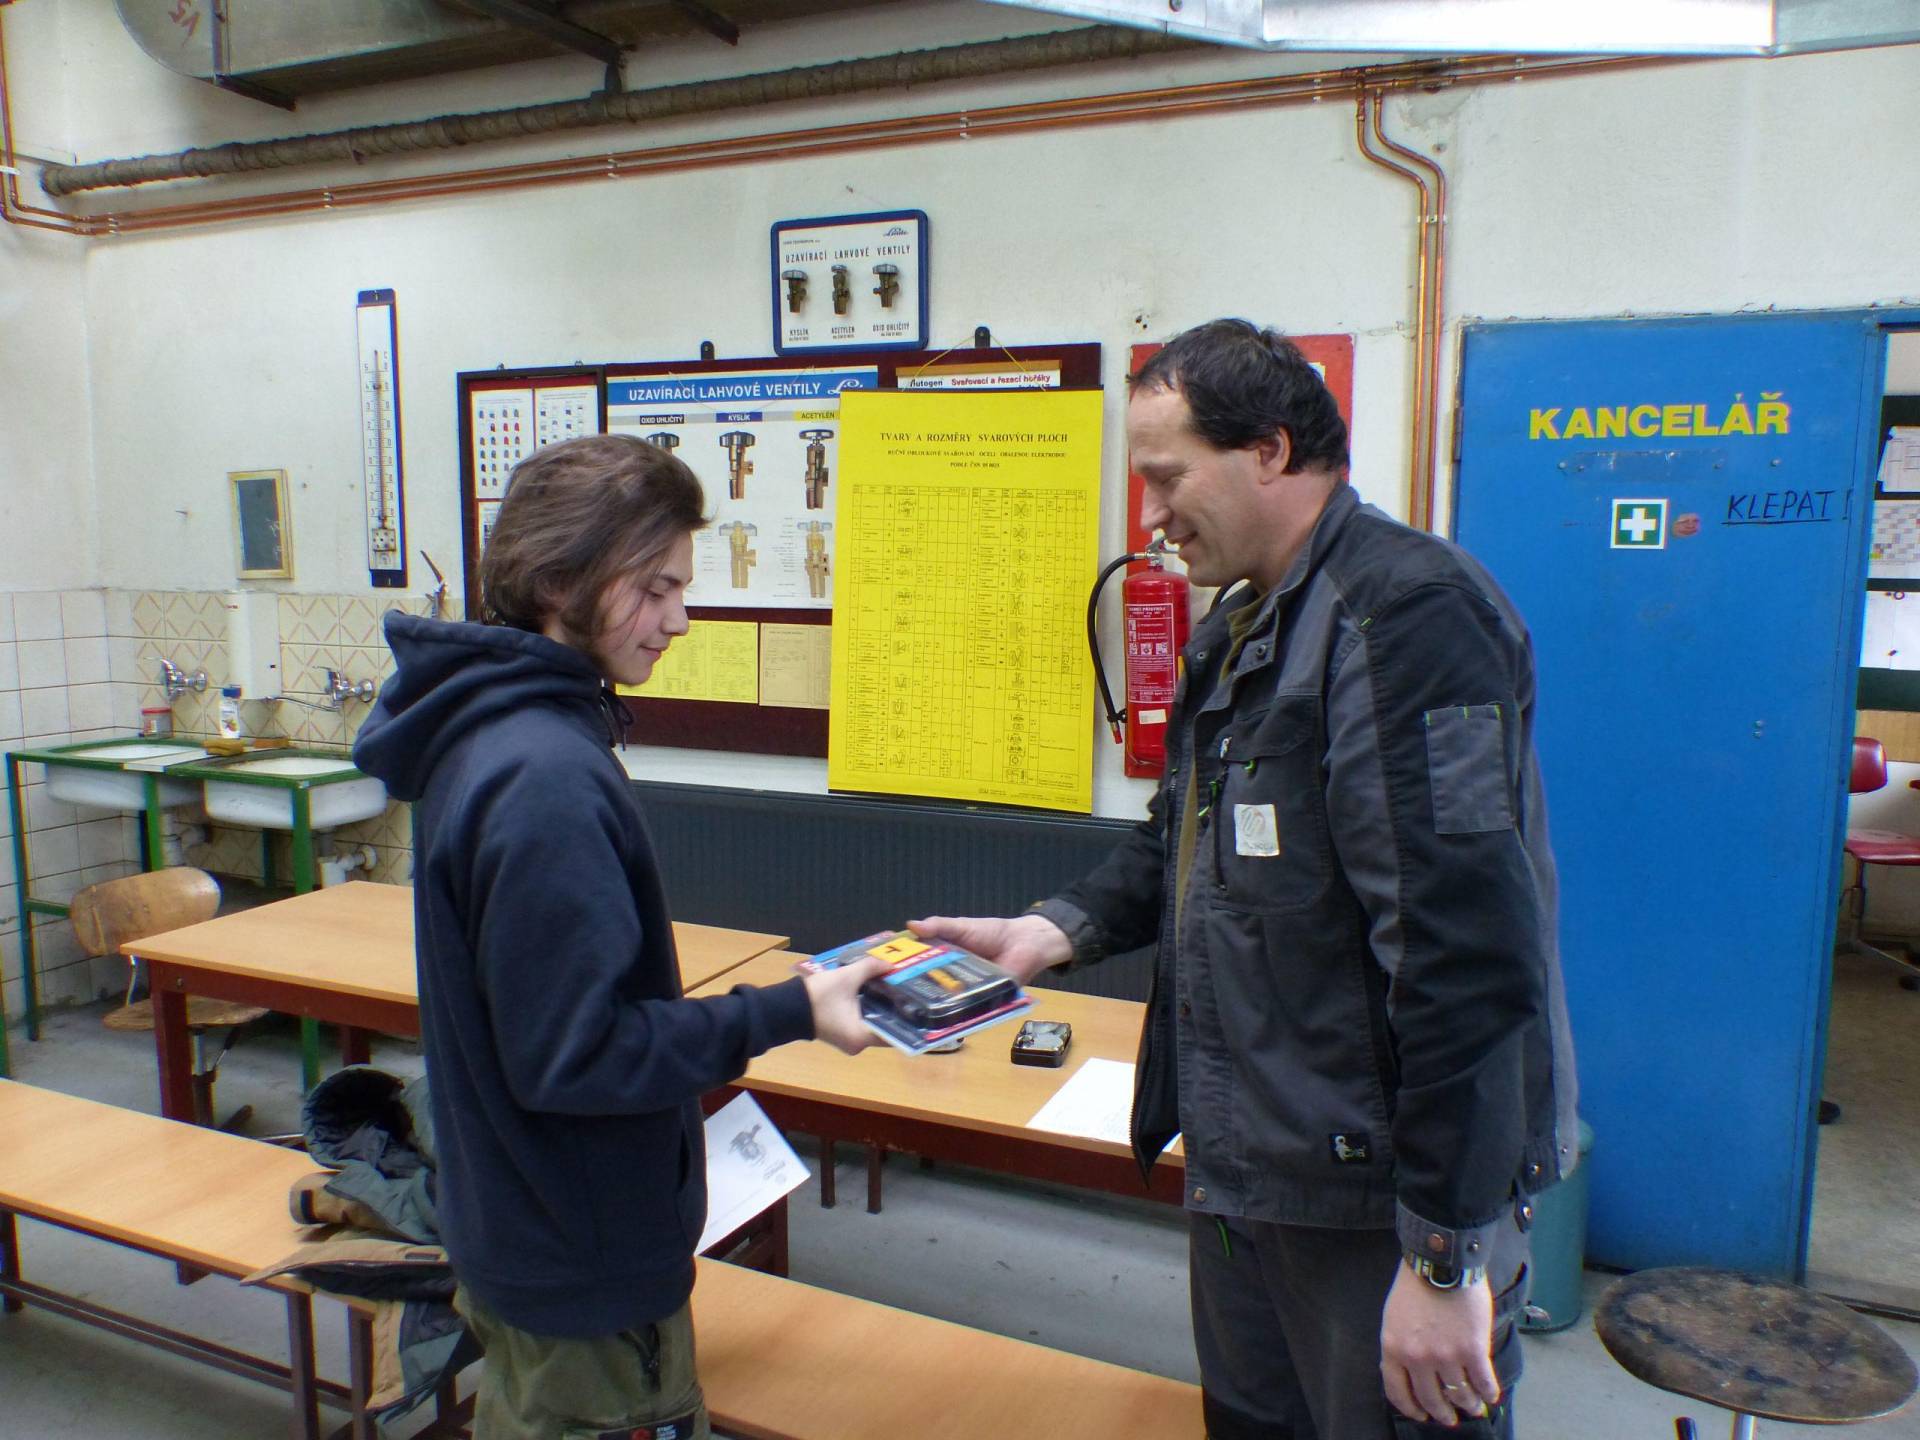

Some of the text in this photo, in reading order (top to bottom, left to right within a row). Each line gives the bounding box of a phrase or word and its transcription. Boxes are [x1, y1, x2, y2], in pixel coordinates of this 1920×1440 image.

[785, 244, 911, 263] UZAVÍRACÍ LAHVOVÉ VENTILY
[909, 379, 943, 388] Autogen
[951, 377, 989, 387] Svařovací
[998, 375, 1022, 385] řezací
[1023, 373, 1051, 384] hořáky
[628, 387, 696, 401] UZAVÍRACÍ
[699, 382, 761, 399] LAHVOVÉ
[765, 382, 821, 396] VENTILY
[728, 413, 751, 422] KYSLÍK
[1528, 392, 1792, 441] KANCELÁŘ
[880, 432, 1068, 442] TVARY A ROZMĚRY SVAROVÝCH PLOCH
[1727, 489, 1836, 519] KLEPAT
